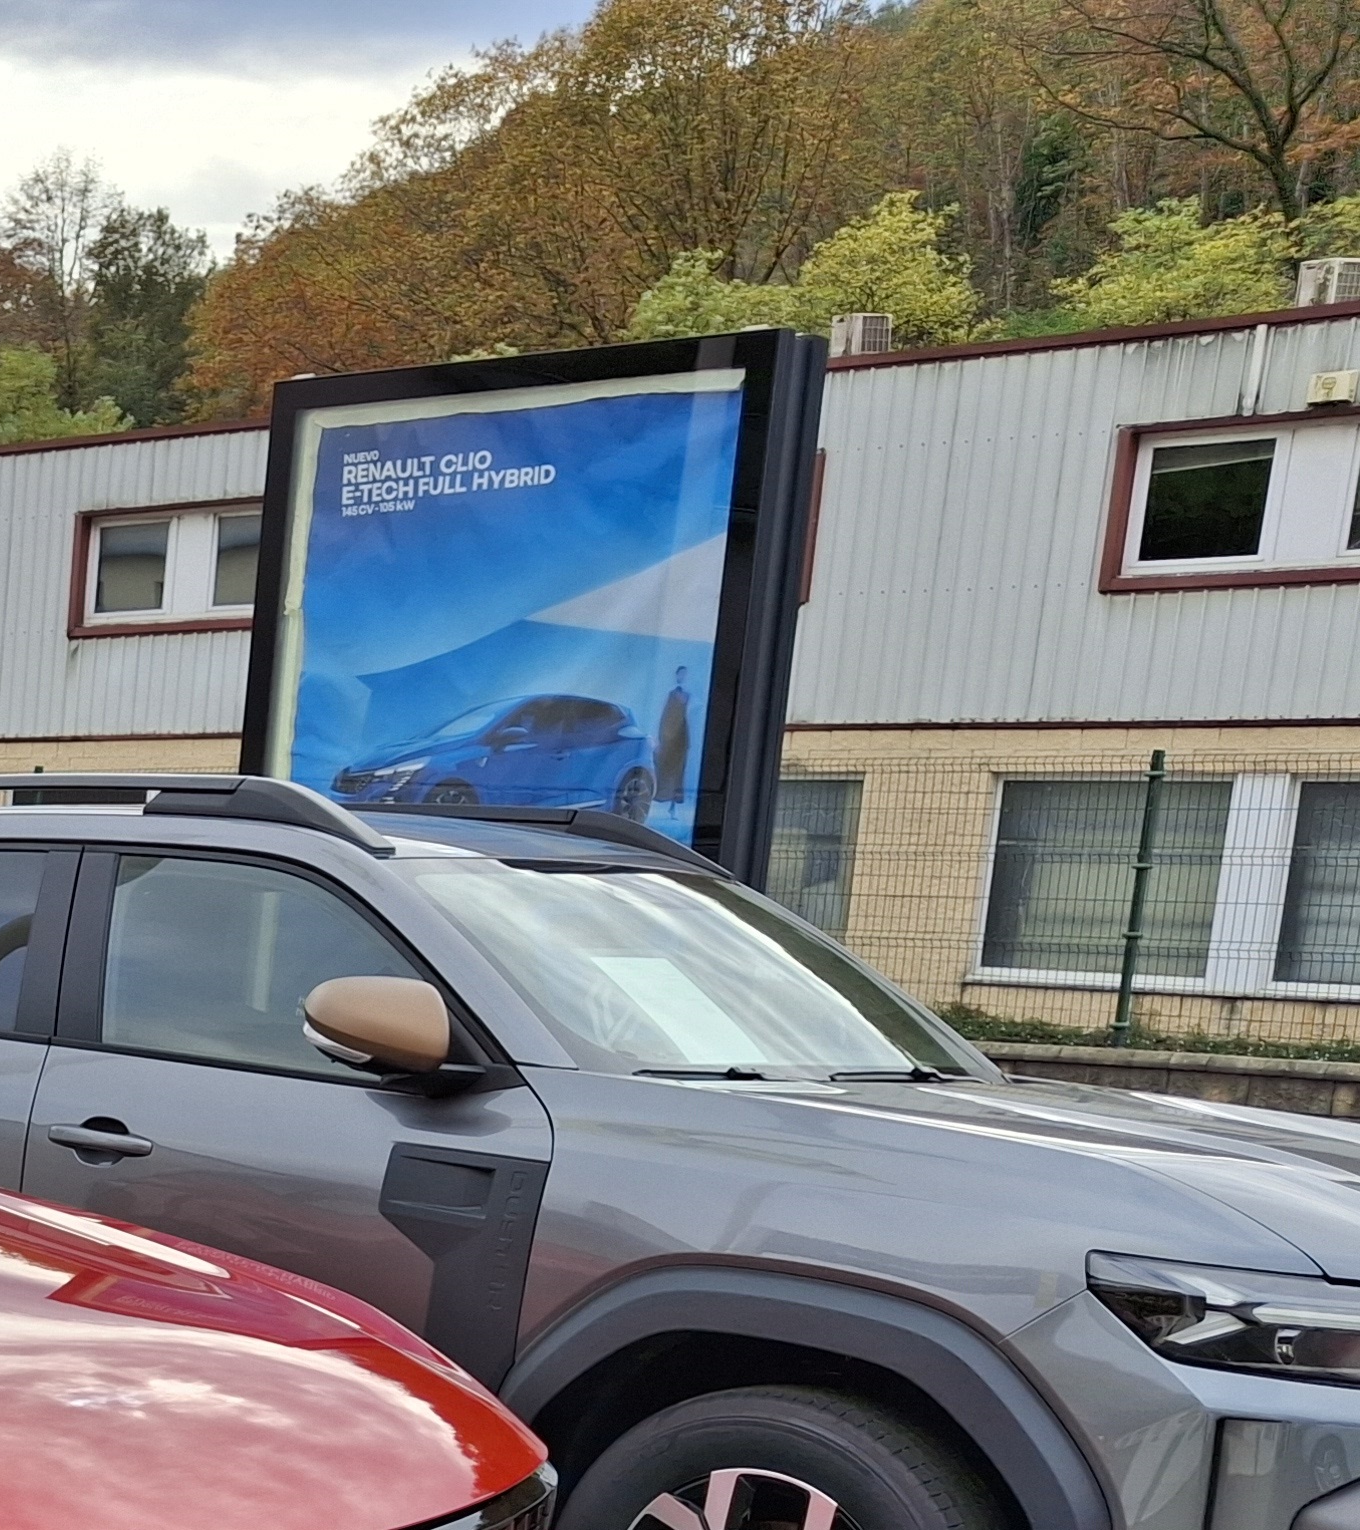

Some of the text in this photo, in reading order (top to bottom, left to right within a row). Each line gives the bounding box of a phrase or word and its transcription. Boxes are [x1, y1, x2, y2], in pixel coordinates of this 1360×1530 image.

[342, 450, 492, 484] RENAULT CLIO
[343, 450, 380, 464] NUEVO
[341, 464, 557, 505] E-TECH FULL HYBRID
